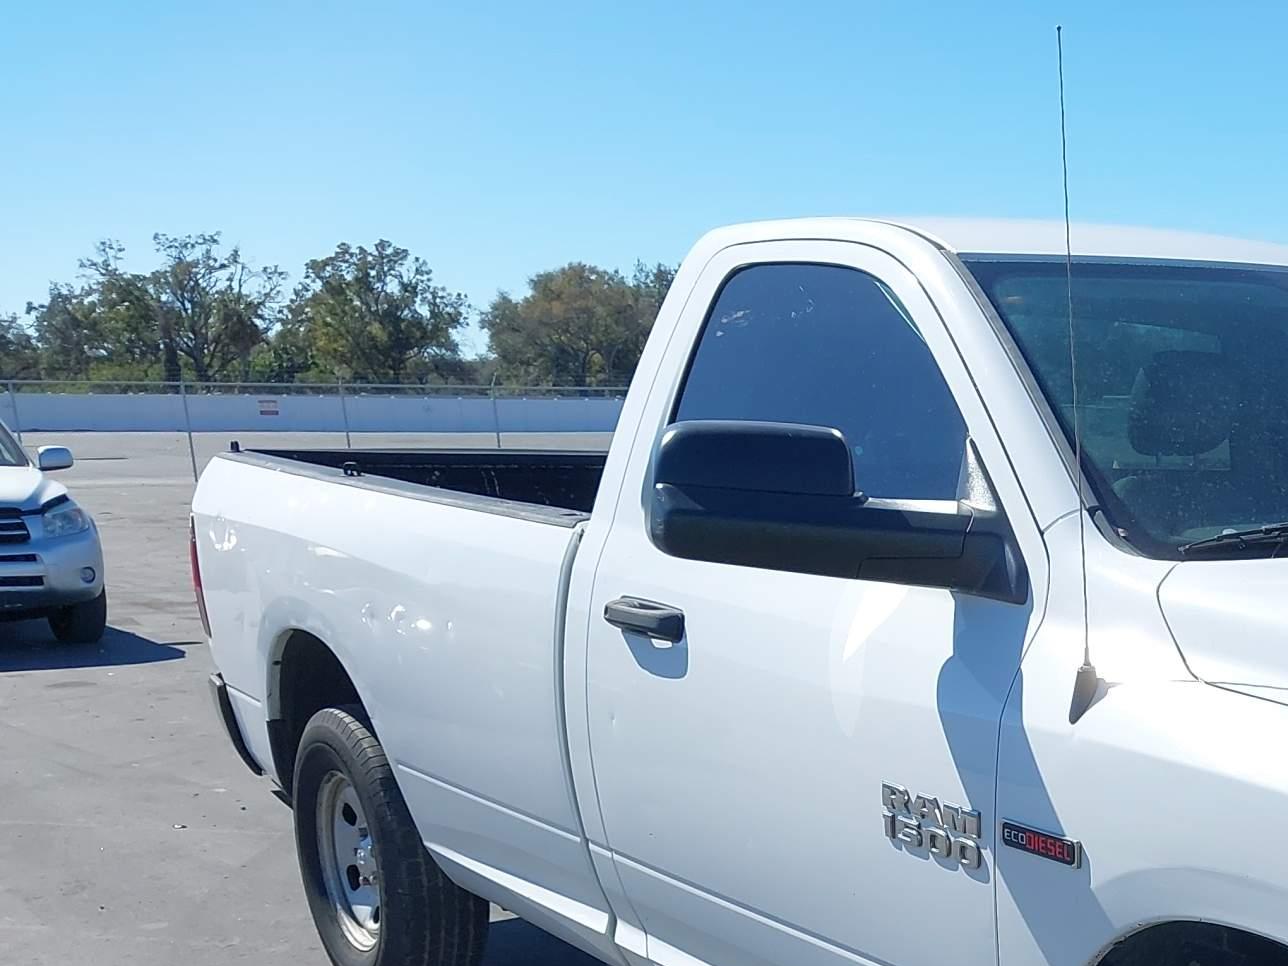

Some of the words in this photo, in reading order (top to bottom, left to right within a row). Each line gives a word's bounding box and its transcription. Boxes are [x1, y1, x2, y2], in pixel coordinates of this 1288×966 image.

[881, 780, 982, 839] RAM
[882, 811, 982, 869] 1500
[1004, 828, 1071, 862] ECODIESEL
